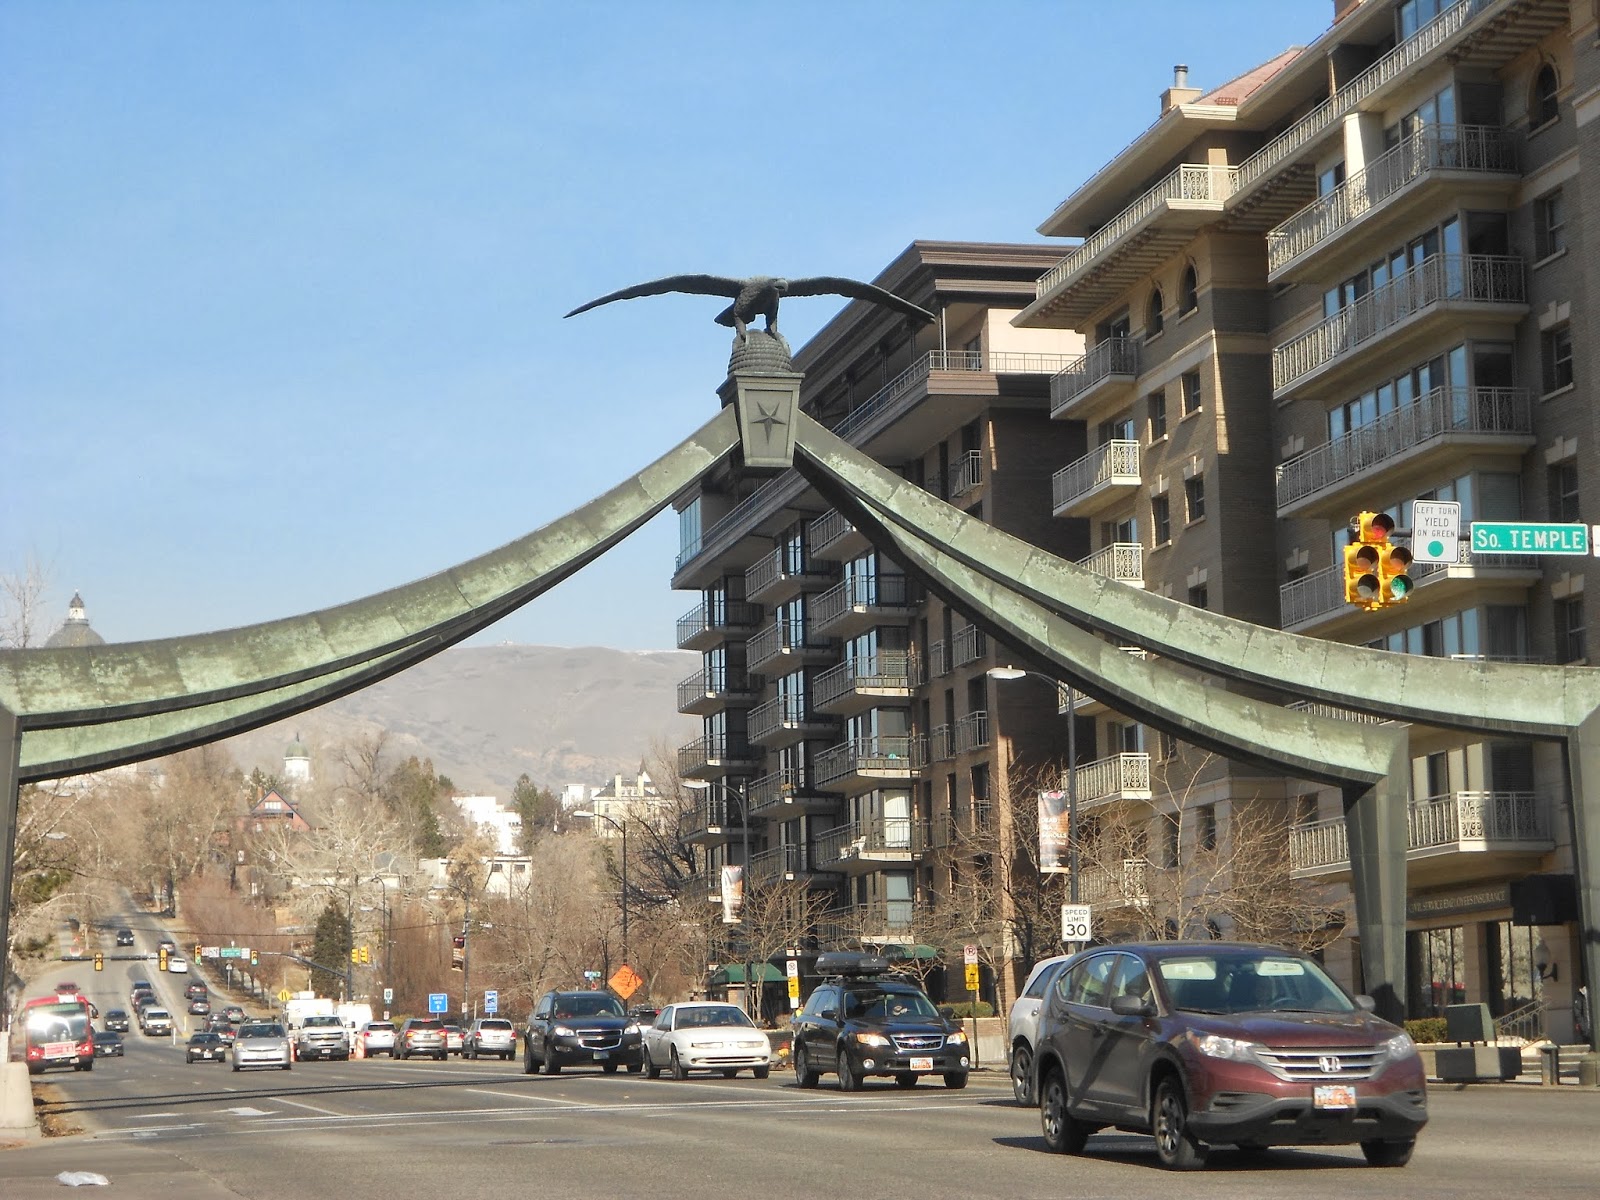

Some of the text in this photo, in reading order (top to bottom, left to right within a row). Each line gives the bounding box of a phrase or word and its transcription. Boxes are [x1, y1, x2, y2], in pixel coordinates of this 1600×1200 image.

[1416, 506, 1457, 515] LEFT TURN
[1424, 517, 1449, 527] YIELD
[1417, 529, 1455, 538] ON GREEN
[1509, 530, 1584, 549] TEMPLE
[1473, 890, 1505, 904] INSURANCE
[1066, 923, 1087, 936] 30
